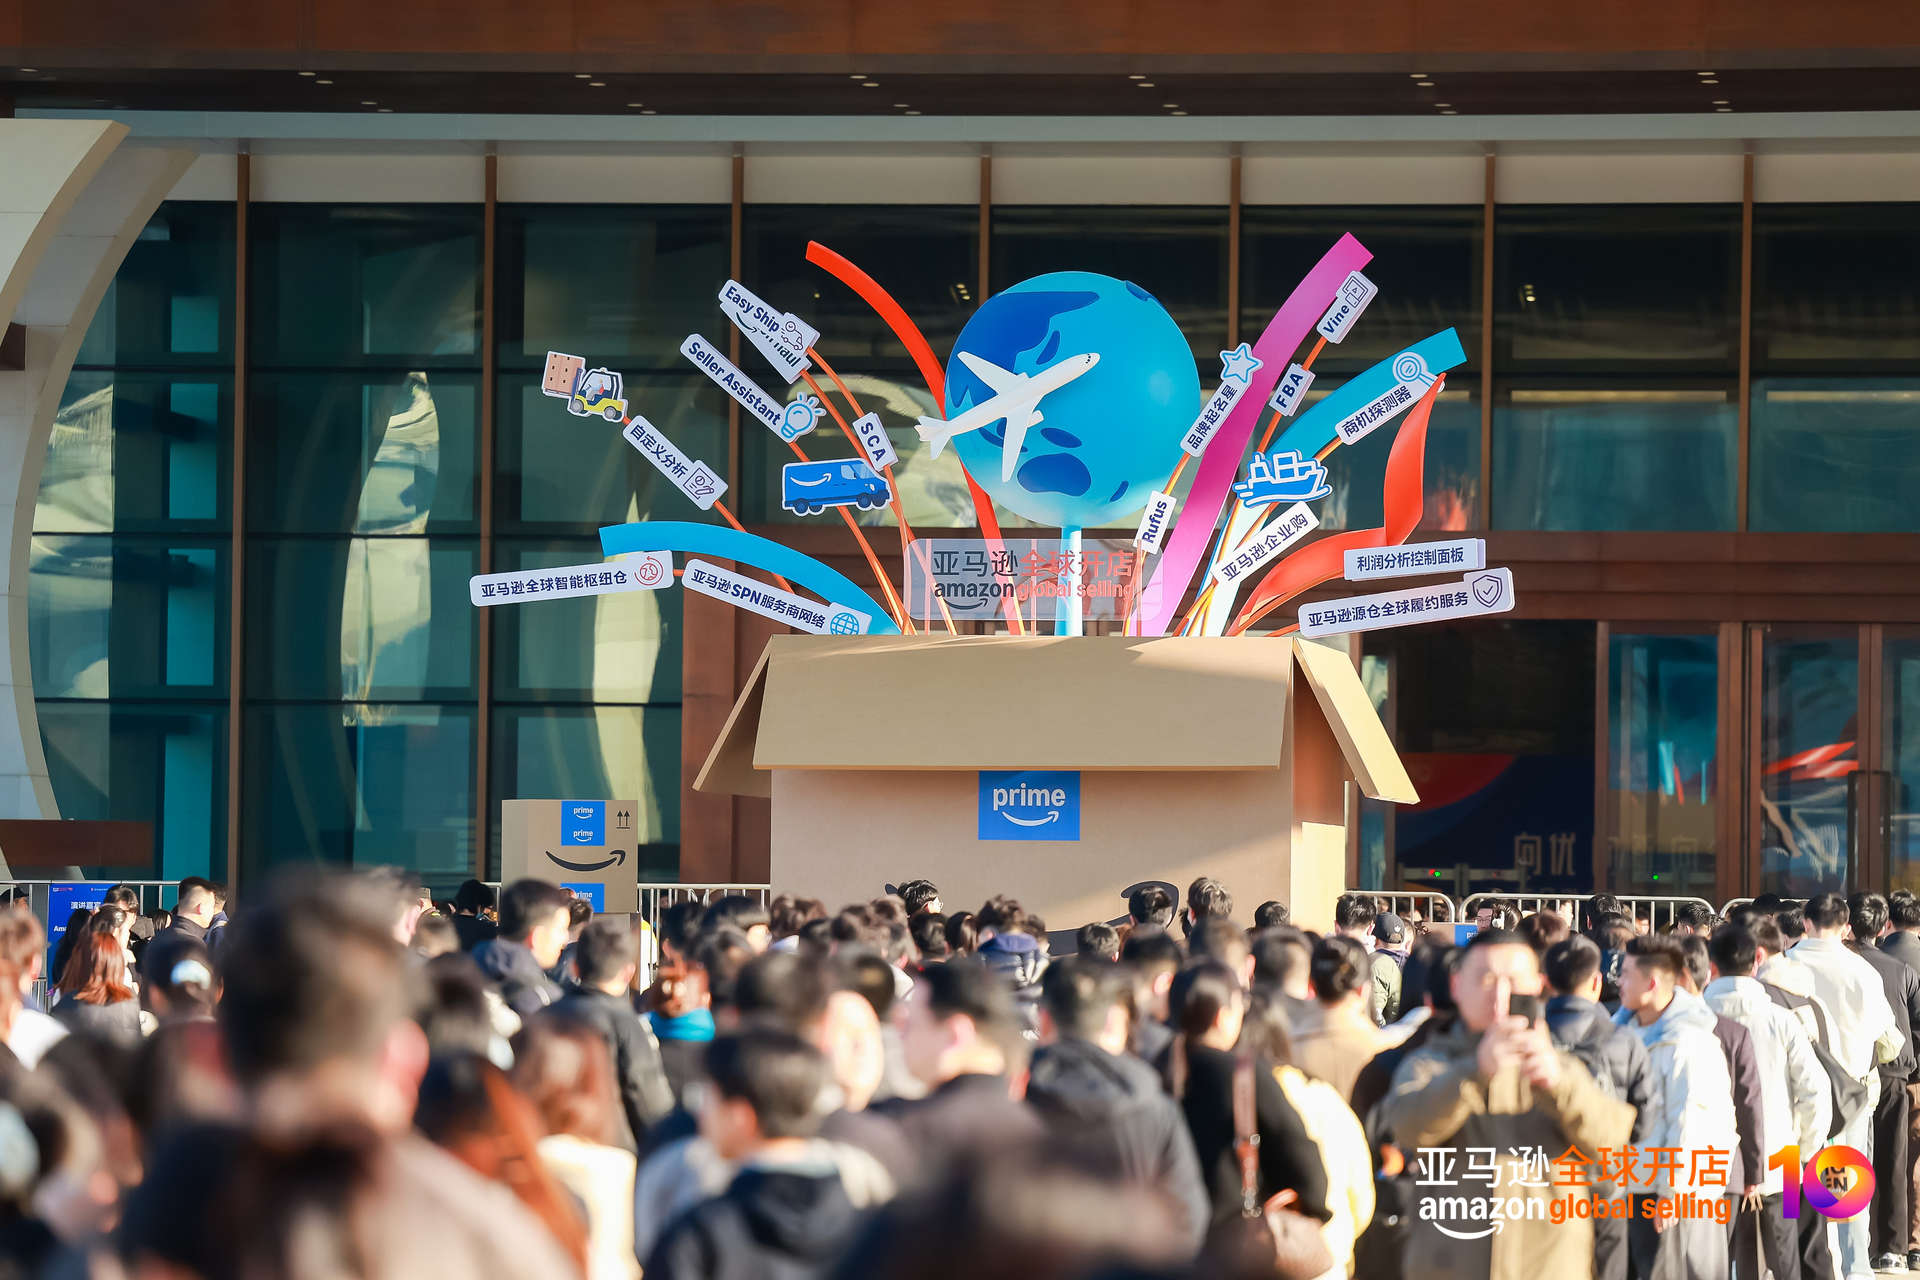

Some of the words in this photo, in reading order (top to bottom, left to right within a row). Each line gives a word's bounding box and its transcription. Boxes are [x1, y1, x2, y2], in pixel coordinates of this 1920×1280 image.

[725, 286, 754, 313] Easy
[753, 306, 780, 332] Ship
[1323, 305, 1350, 335] Vine
[688, 342, 725, 376] Seller
[722, 372, 781, 426] Assistant
[1275, 373, 1304, 408] FBA
[1187, 384, 1238, 450] 品牌起名星
[1341, 385, 1412, 438] 商机探测器
[630, 424, 689, 479] 自定义分析
[860, 421, 887, 462] SCA
[1141, 500, 1168, 544] Rufus
[932, 549, 1134, 578] 亚马逊全球开店
[1221, 513, 1309, 582] 亚马逊企业购
[1357, 546, 1464, 572] 利润分析控制面板
[481, 570, 628, 598] 亚马逊全球智能枢纽仓
[690, 568, 826, 629] 亚马逊SPN服务商网络
[934, 582, 1015, 598] amazon
[1016, 580, 1072, 602] global
[1308, 591, 1469, 628] 亚马逊源仓全球履约服务
[573, 806, 594, 815] prime
[993, 782, 1066, 811] prime
[573, 829, 594, 838] prime
